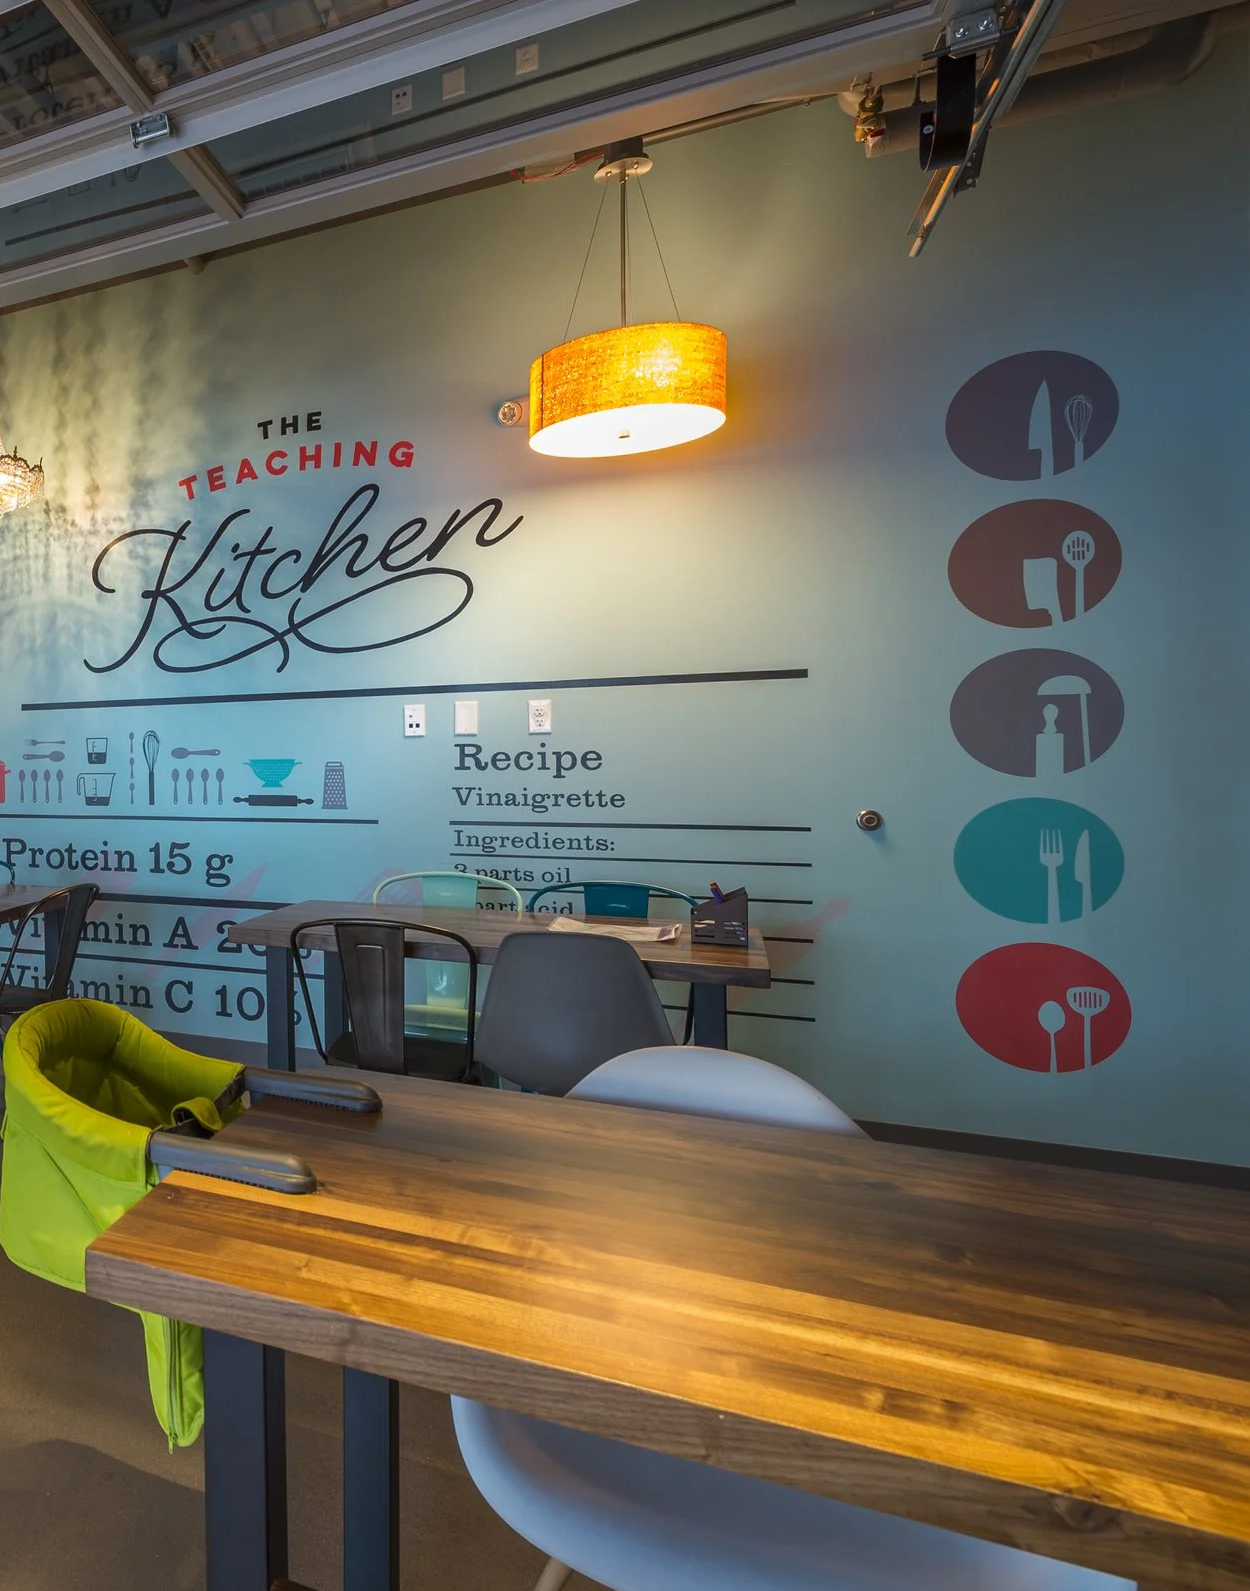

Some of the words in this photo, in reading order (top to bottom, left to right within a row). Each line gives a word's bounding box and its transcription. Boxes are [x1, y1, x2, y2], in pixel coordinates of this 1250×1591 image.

[257, 410, 323, 440] THE
[178, 440, 415, 500] TEACHING
[83, 483, 524, 674] Kitchen
[453, 742, 603, 778] Recipe
[452, 786, 626, 813] Vinaigrette
[453, 829, 616, 854] Ingredients:
[2, 837, 138, 873] Protein
[148, 841, 193, 875] 15
[205, 853, 234, 887] g
[541, 867, 572, 883] oil
[162, 915, 199, 950] A
[164, 979, 194, 1014] C
